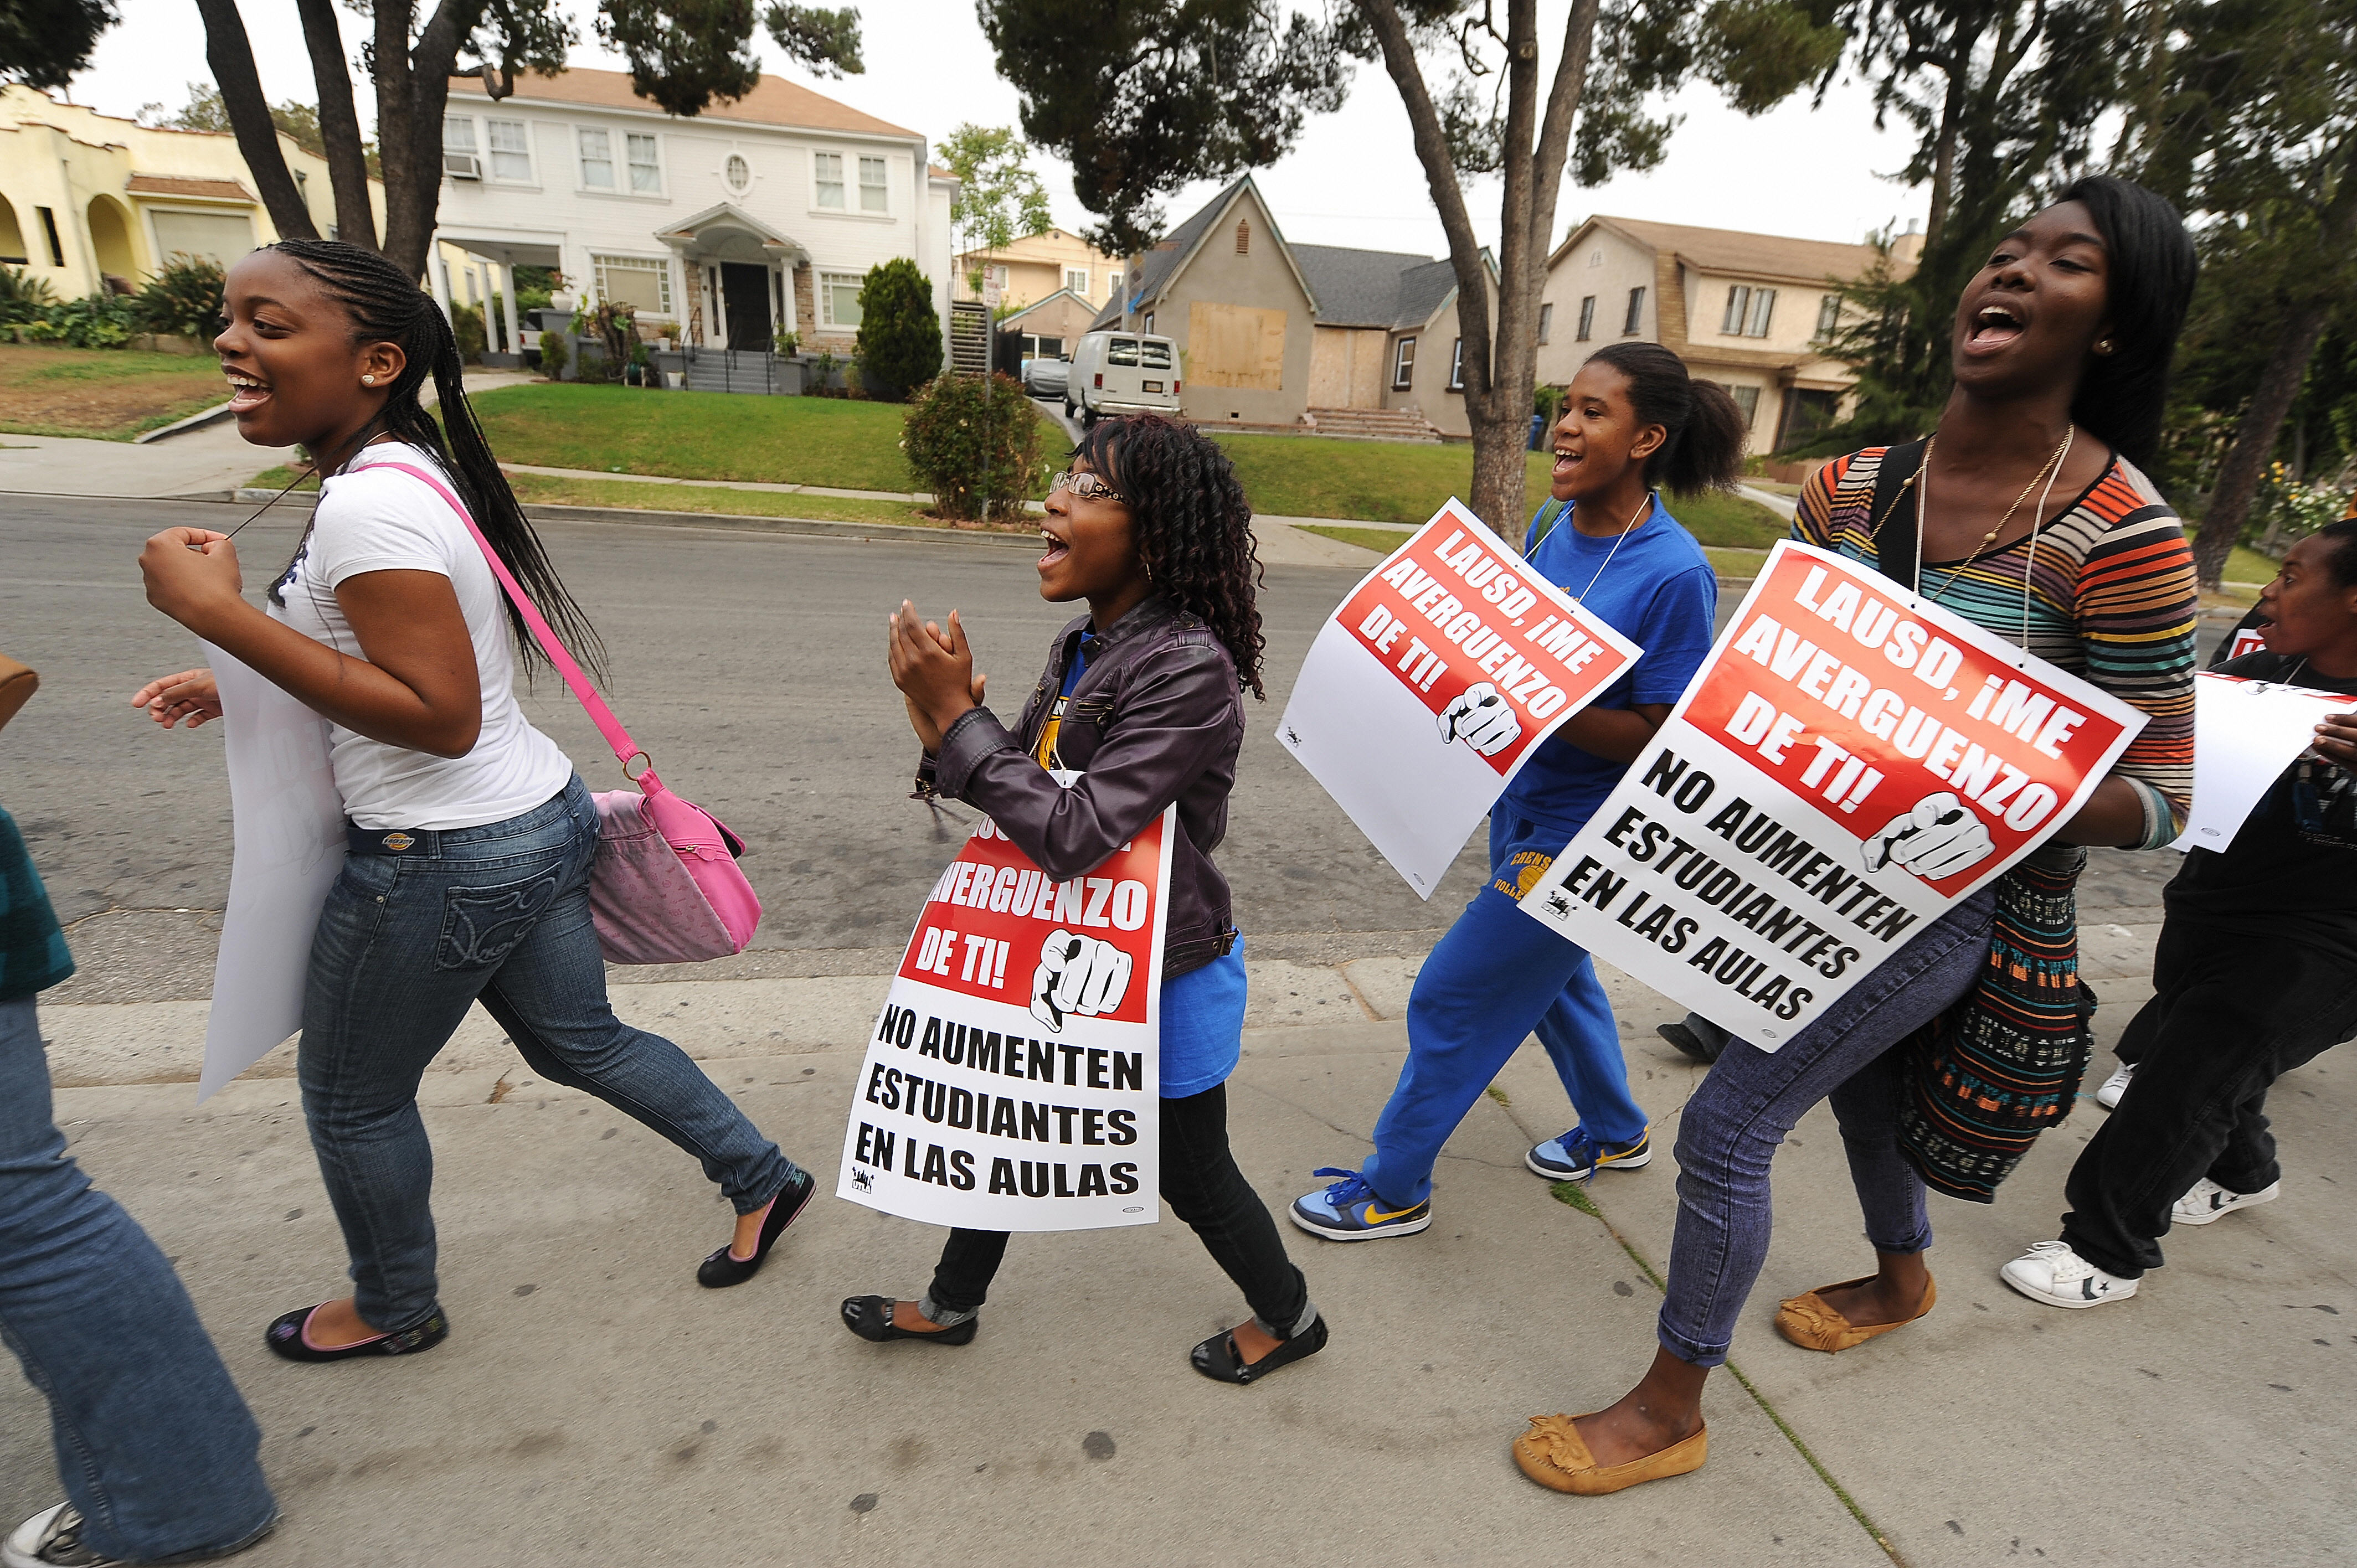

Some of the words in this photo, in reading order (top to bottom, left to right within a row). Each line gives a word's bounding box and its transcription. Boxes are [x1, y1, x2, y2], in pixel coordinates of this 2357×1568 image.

[1358, 603, 1408, 655] DE
[1397, 636, 1449, 693] TI!
[1380, 557, 1567, 720] AVERGUENZO
[1433, 528, 1538, 627] LAUSD,
[1523, 614, 1604, 675] ¡ME
[1793, 565, 1965, 700] LAUSD,
[1965, 674, 2087, 760] ¡ME
[1723, 690, 1807, 766] DE
[1799, 735, 1885, 814] TI!
[1732, 612, 2058, 832] AVERGUENZO
[928, 861, 1148, 931] AVERGUENZO
[1602, 804, 1861, 980] ESTUDIANTES
[1639, 747, 1716, 814] NO
[1704, 796, 1921, 943] AUMENTEN
[915, 926, 959, 976] DE
[961, 933, 1011, 989] TI!
[1560, 854, 1630, 912] EN
[1615, 890, 1700, 955] LAS
[1686, 935, 1814, 1022] AULAS
[866, 1062, 1138, 1146] ESTUDIANTES
[878, 1003, 917, 1050] NO
[919, 1016, 1143, 1091] AUMENTEN
[853, 1180, 871, 1194] UTLA
[855, 1121, 896, 1172] EN
[904, 1137, 976, 1191] LAS
[987, 1157, 1140, 1198] AULAS
